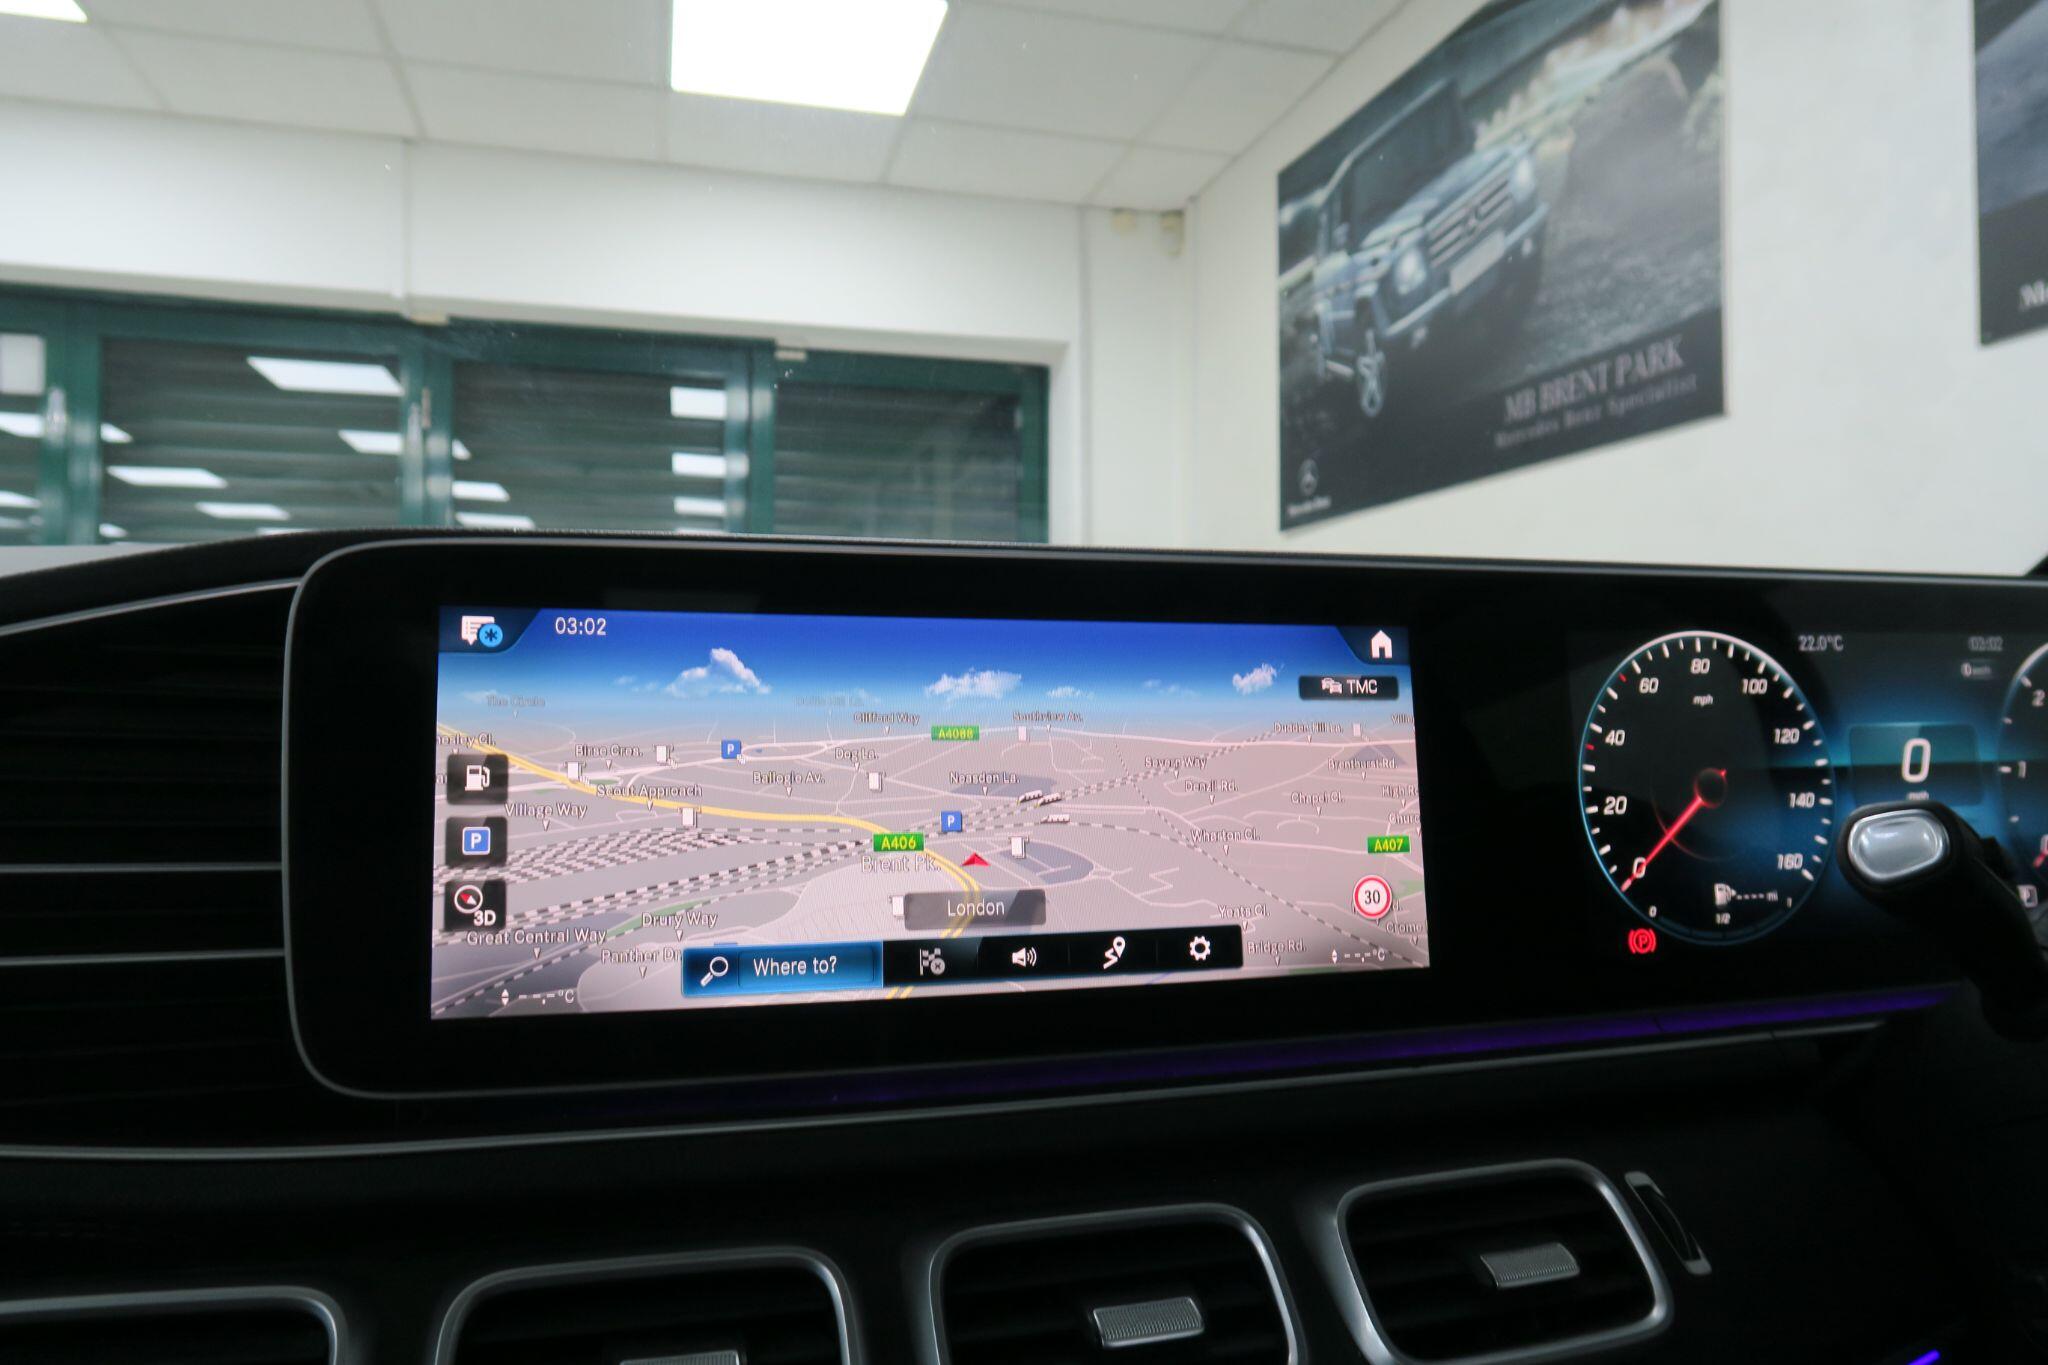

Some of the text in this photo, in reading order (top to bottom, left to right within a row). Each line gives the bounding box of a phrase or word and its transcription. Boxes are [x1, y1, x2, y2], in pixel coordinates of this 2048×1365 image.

[1539, 359, 1611, 414] BRENT
[1614, 334, 1684, 388] PARK
[555, 617, 607, 635] 03:02
[1690, 658, 1710, 674] 80
[1346, 679, 1378, 694] TMC
[1639, 677, 1659, 694] 60
[1742, 678, 1768, 694] 100
[1693, 694, 1713, 706] mph
[2032, 689, 2045, 706] 2
[1605, 730, 1625, 746] 40
[1774, 728, 1799, 744] 120
[835, 747, 859, 762] Dog
[1183, 755, 1207, 769] Way
[1902, 738, 1931, 783] 0
[1381, 757, 1398, 769] Rd.
[2018, 760, 2026, 778] 1
[805, 771, 825, 785] Av.
[949, 771, 1020, 785] Neasden La.
[597, 784, 703, 800] Scout Approach
[1789, 792, 1815, 808] 140
[505, 803, 587, 819] Village Way
[1604, 796, 1627, 815] 20
[881, 836, 917, 850] A406
[1374, 838, 1404, 852] A407
[861, 853, 942, 873] Brent Pk.
[1632, 857, 1646, 878] 0
[1777, 853, 1803, 869] 160
[1364, 889, 1380, 905] 30
[947, 899, 1005, 917] London
[1649, 905, 1657, 917] 0
[473, 910, 496, 926] 3D
[641, 911, 718, 930] Drury Way
[466, 928, 608, 946] Great Central Way
[1247, 938, 1308, 956] Bridge Rd.
[602, 947, 660, 964] Panther
[753, 956, 838, 977] Where to?
